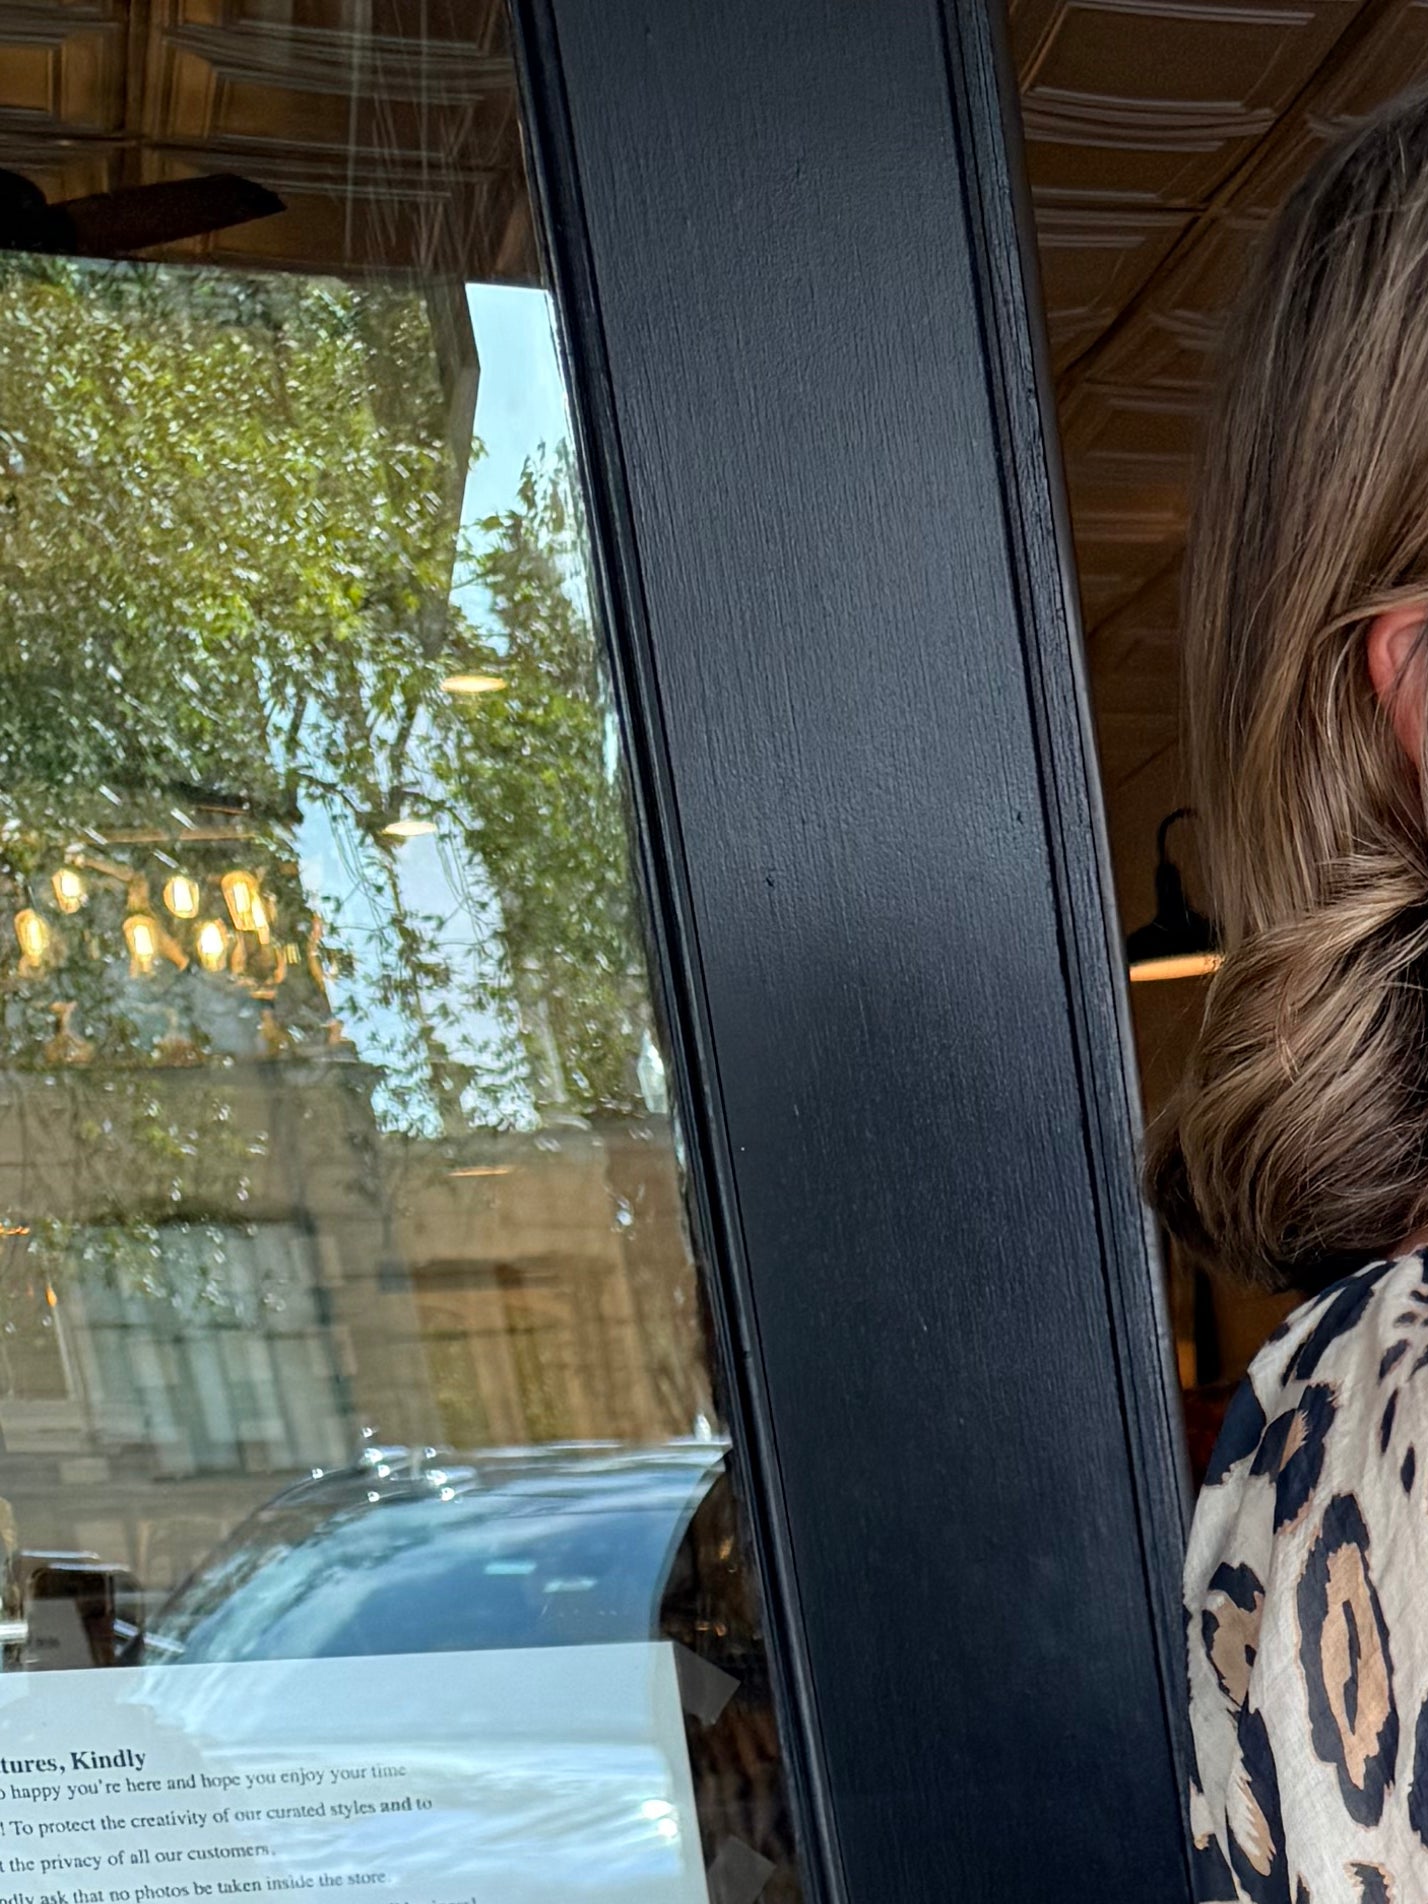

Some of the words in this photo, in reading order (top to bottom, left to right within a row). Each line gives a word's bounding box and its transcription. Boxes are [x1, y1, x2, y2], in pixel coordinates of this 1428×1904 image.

[70, 1749, 147, 1772] Kindly
[10, 1784, 61, 1803] happy
[67, 1778, 121, 1800] you're
[126, 1777, 162, 1793] here
[167, 1774, 196, 1790] and
[201, 1773, 241, 1791] hope
[245, 1773, 277, 1789] you
[280, 1767, 325, 1786] enjoy
[330, 1766, 367, 1784] your
[371, 1763, 407, 1779] time
[9, 1820, 33, 1836] To
[38, 1817, 96, 1838] protect
[100, 1815, 126, 1831] the
[130, 1809, 207, 1829] creativity
[212, 1808, 231, 1824] of
[234, 1809, 262, 1822] our
[266, 1802, 326, 1820] curated
[330, 1799, 376, 1819] styles
[380, 1796, 412, 1814] and
[415, 1797, 433, 1811] to
[9, 1857, 35, 1873] the
[40, 1853, 102, 1874] privacy
[107, 1850, 125, 1866] of
[130, 1848, 150, 1865] all
[155, 1849, 183, 1863] our
[73, 1888, 104, 1904] that
[109, 1890, 130, 1903] no
[135, 1884, 190, 1904] photos
[193, 1881, 213, 1895] be
[217, 1875, 262, 1894] taken
[266, 1874, 314, 1892] inside
[319, 1872, 343, 1888] the
[347, 1871, 392, 1886] store.
